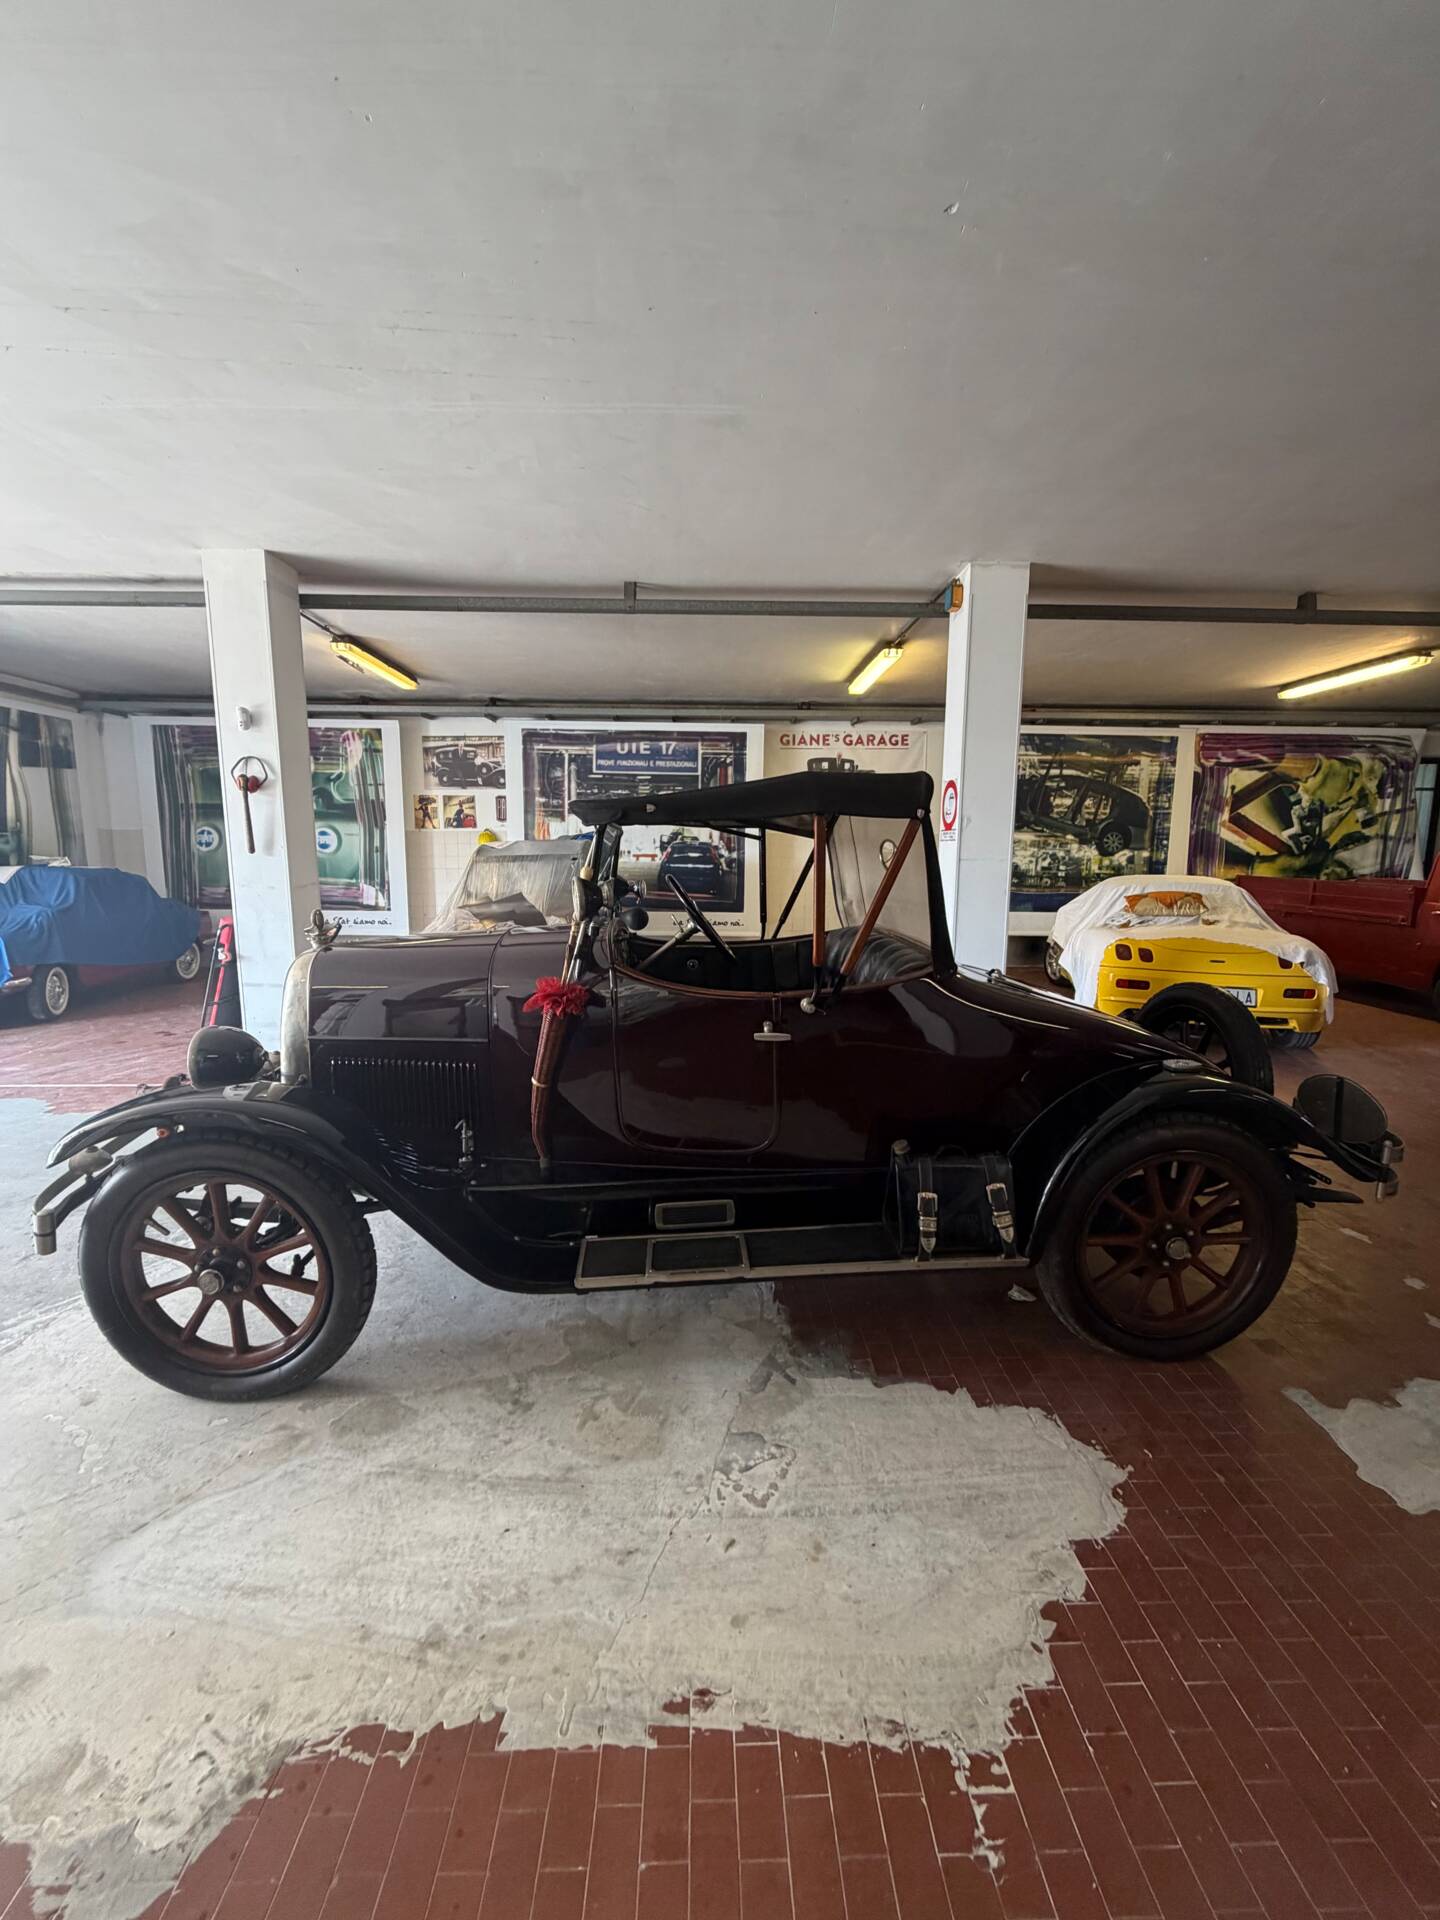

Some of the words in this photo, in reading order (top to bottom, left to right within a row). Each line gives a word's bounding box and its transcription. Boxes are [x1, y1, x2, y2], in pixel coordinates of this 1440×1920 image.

[780, 734, 840, 746] GIANE'S
[843, 734, 910, 746] GARAGE
[659, 741, 677, 755] 17
